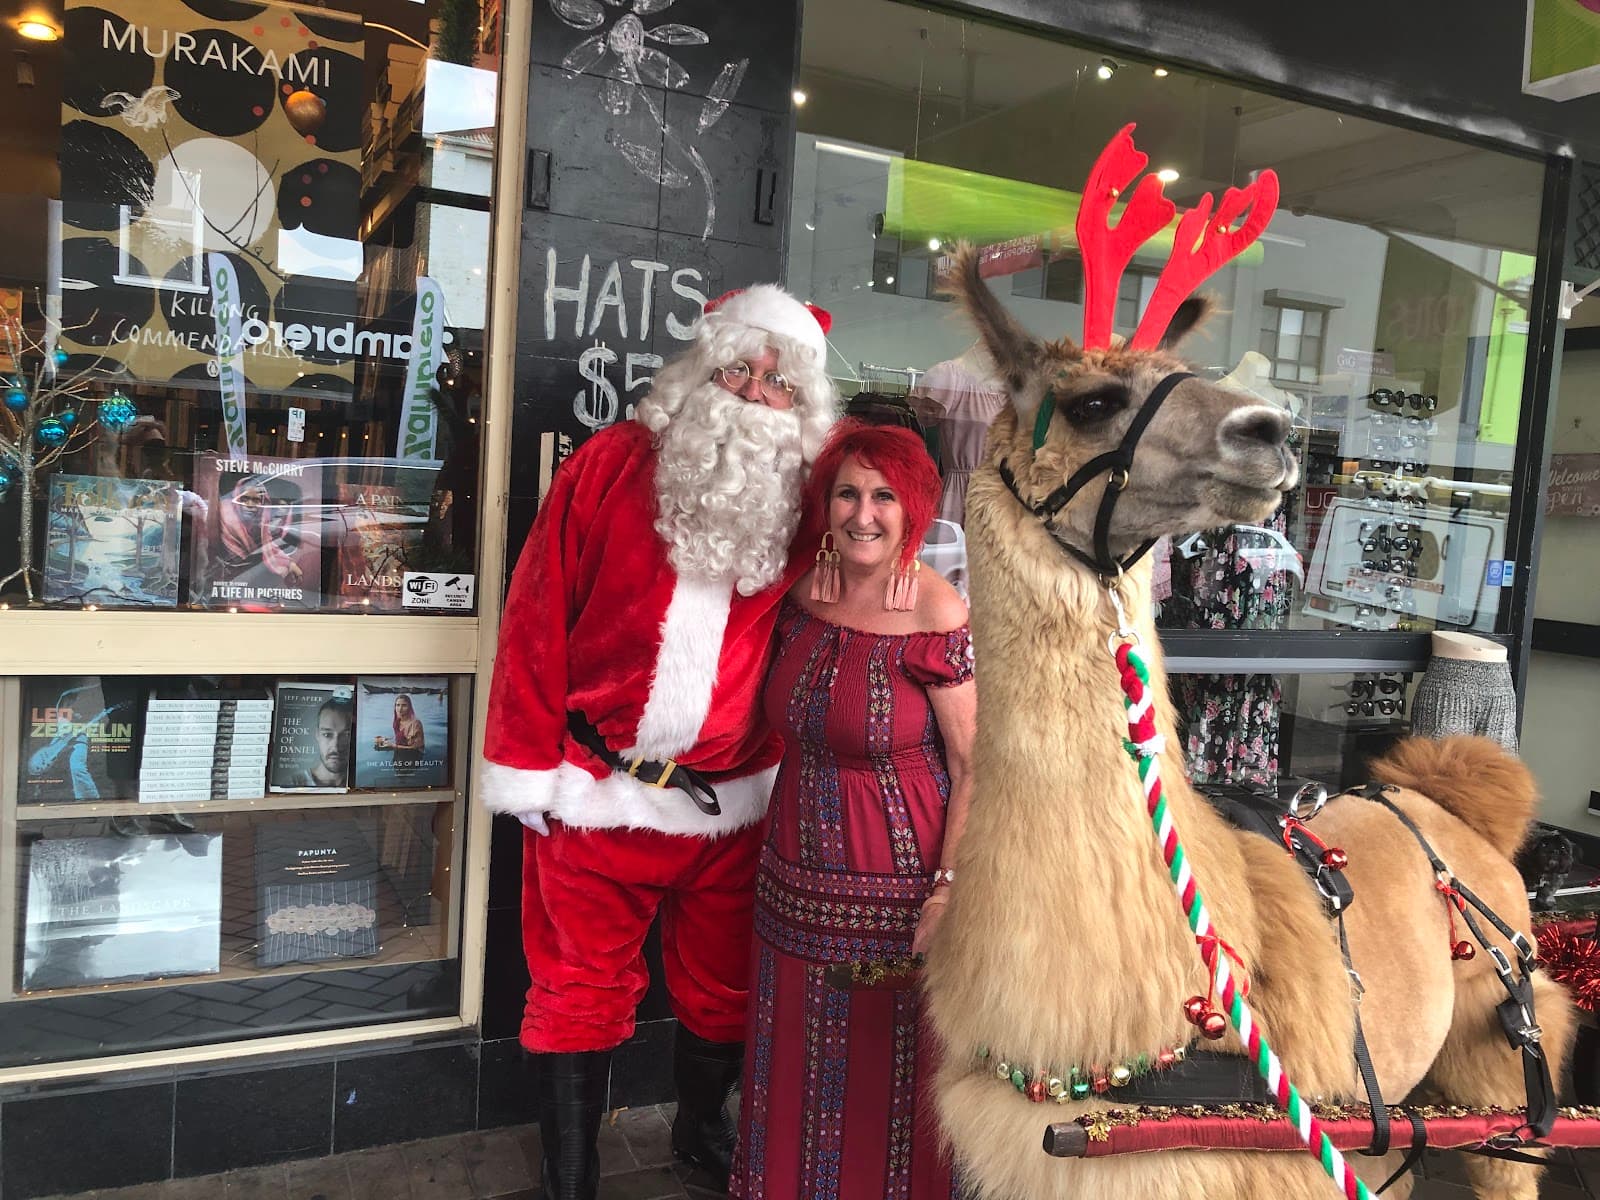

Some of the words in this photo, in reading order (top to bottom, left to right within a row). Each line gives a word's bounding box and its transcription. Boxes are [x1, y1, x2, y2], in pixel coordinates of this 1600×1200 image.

[102, 18, 331, 88] MURAKAMI
[546, 247, 706, 341] HATS
[171, 290, 258, 320] KILLING
[113, 318, 304, 360] COMMENDATORE
[216, 459, 250, 474] STEVE
[252, 461, 305, 477] McCURRY
[355, 493, 366, 505] A
[211, 586, 219, 598] A
[221, 587, 241, 599] LIFE
[244, 587, 254, 599] IN
[257, 588, 303, 601] PICTURES
[31, 707, 73, 722] LED
[283, 717, 302, 726] THE
[30, 723, 132, 738] ZEPPELIN
[282, 727, 310, 735] BOOK
[280, 746, 315, 755] DANIEL
[298, 848, 337, 856] PAPUNYA
[58, 905, 89, 916] THE
